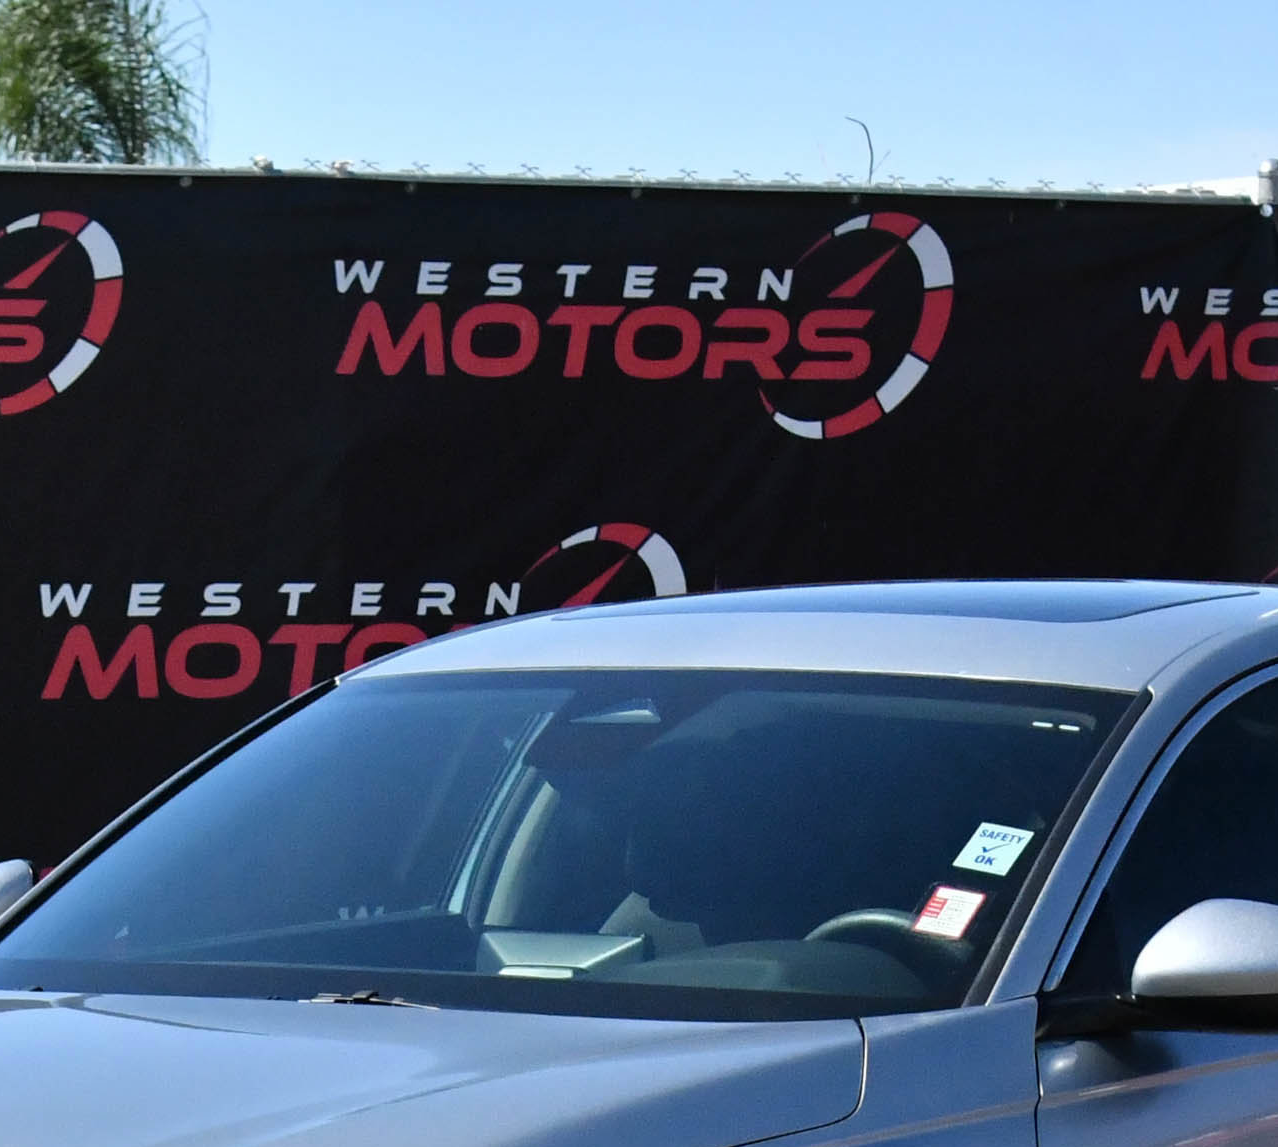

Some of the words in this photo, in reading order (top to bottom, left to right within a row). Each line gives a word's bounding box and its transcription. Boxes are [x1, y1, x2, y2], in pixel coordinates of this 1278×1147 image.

[334, 259, 794, 301] WESTERN
[335, 301, 875, 380] MOTORS
[39, 582, 521, 618] WESTERN
[979, 829, 1025, 844] SAFETY
[974, 854, 996, 866] OK
